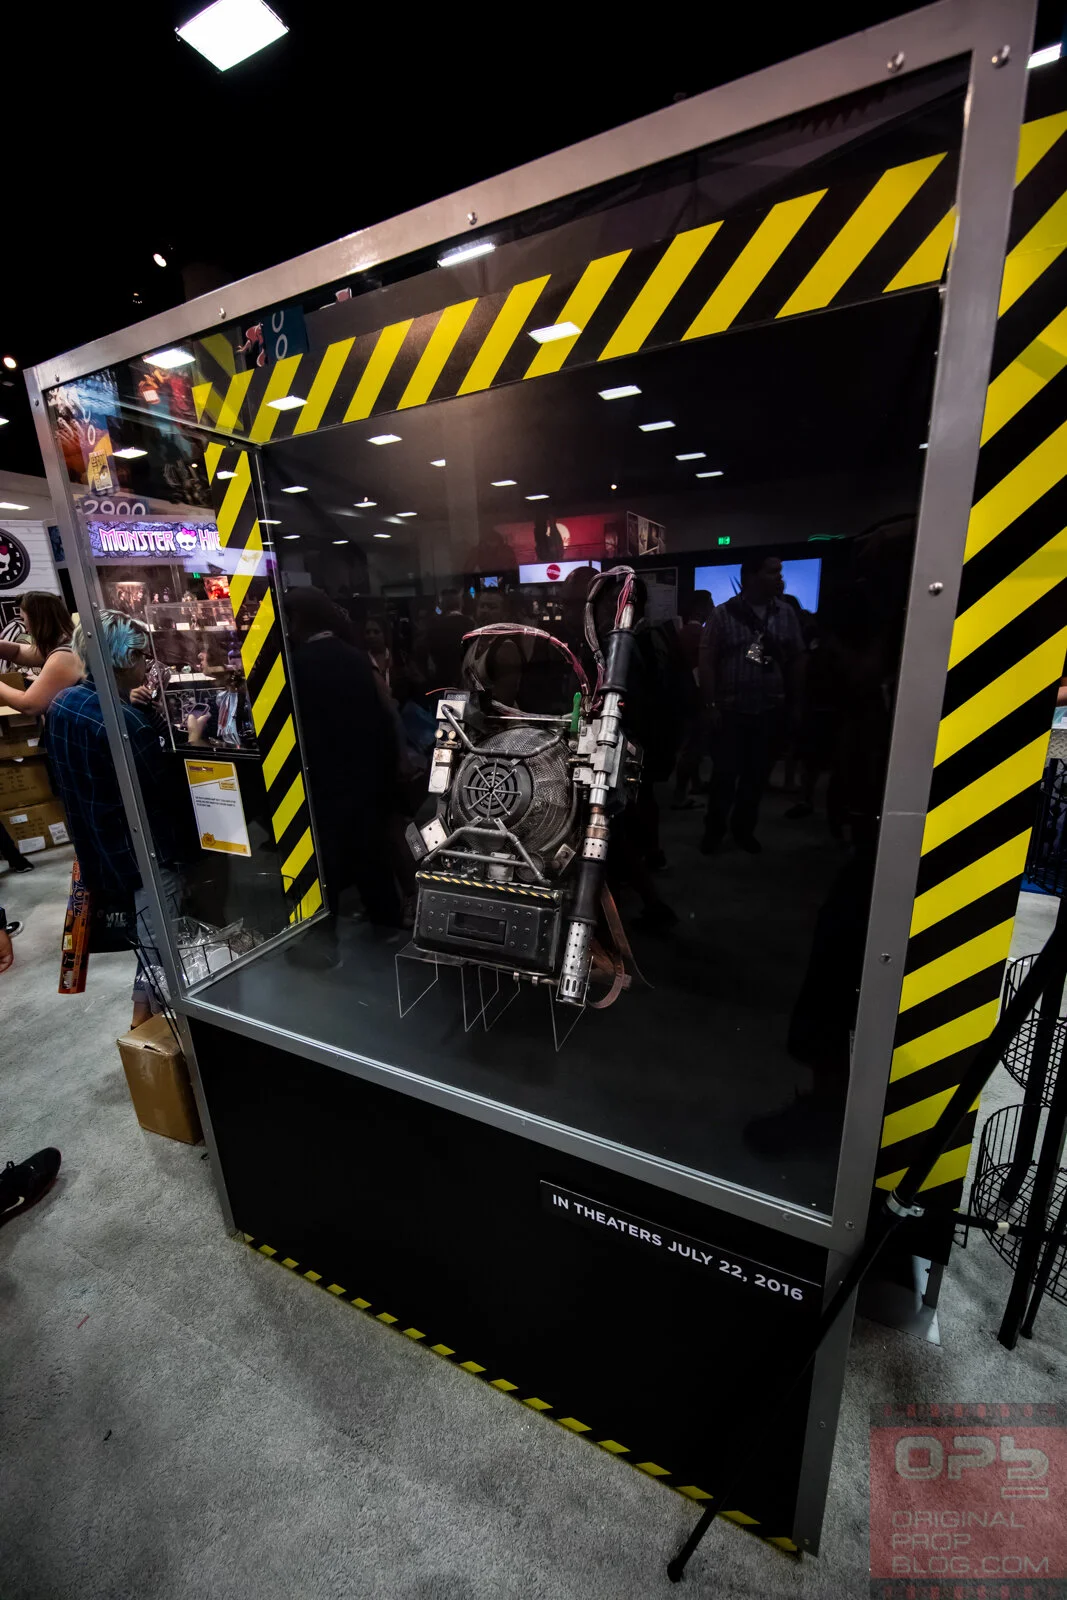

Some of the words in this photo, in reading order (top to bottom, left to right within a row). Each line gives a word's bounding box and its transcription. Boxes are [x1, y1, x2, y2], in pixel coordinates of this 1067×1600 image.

[83, 499, 147, 516] 2900
[98, 528, 177, 552] MONSTER
[552, 1193, 569, 1210] IN
[573, 1202, 663, 1247] THEATERS
[667, 1240, 713, 1266] JULY
[719, 1259, 748, 1283] 22,
[754, 1272, 804, 1302] 2016
